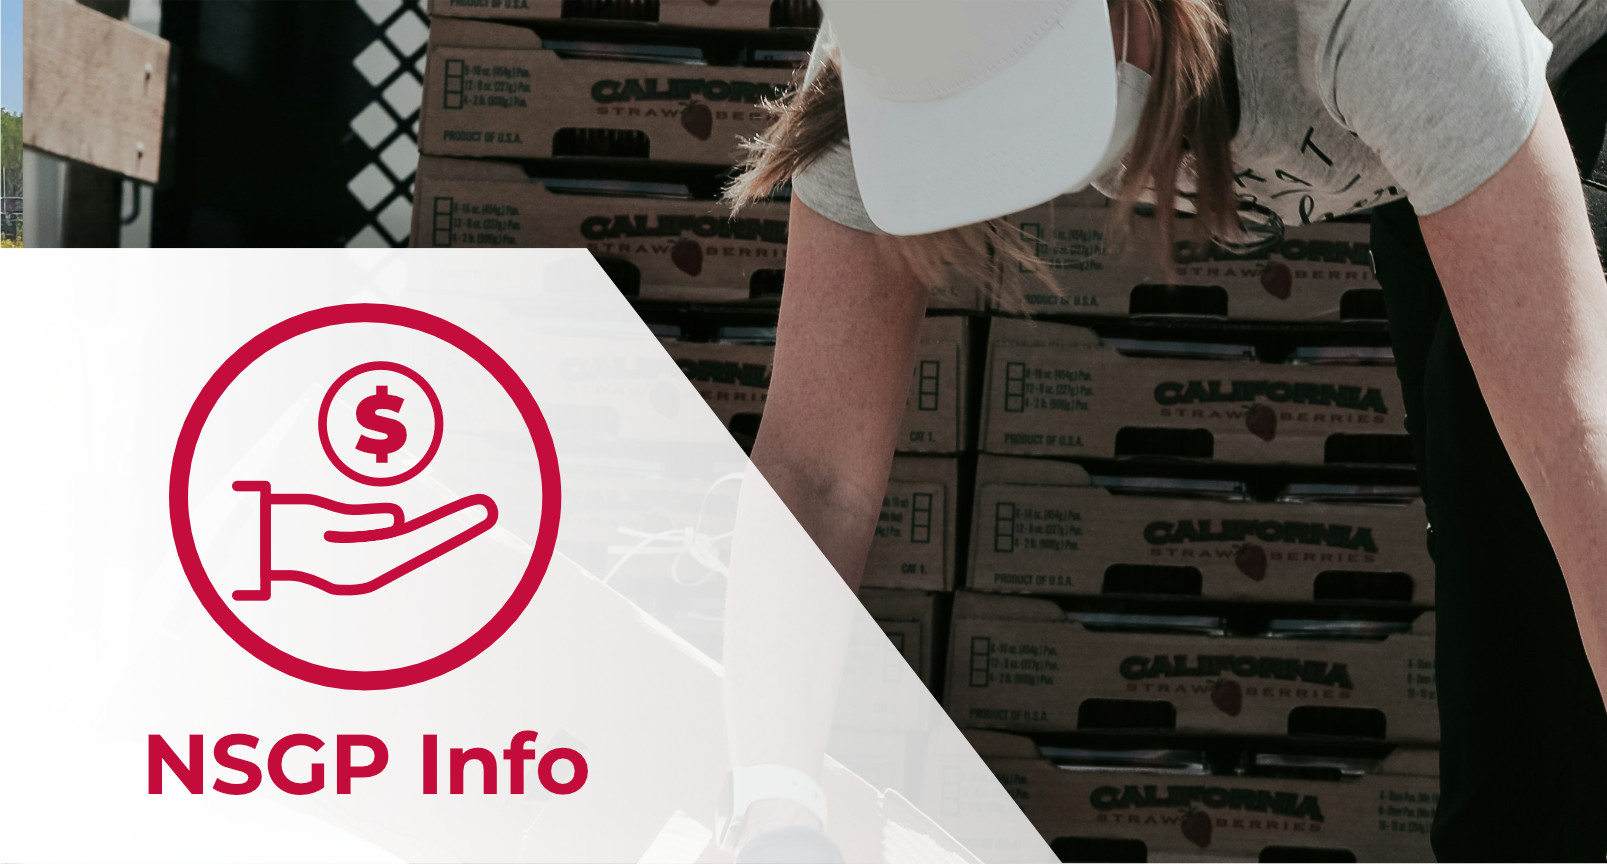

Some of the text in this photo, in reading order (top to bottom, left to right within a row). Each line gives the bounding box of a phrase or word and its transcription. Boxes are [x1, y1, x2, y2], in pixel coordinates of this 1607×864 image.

[1154, 380, 1389, 414] CALIFORNIA
[1144, 520, 1379, 553] CALIFORNIA
[1120, 655, 1353, 691] CALIFORNIA
[1090, 785, 1324, 823] CALIFORNIA
